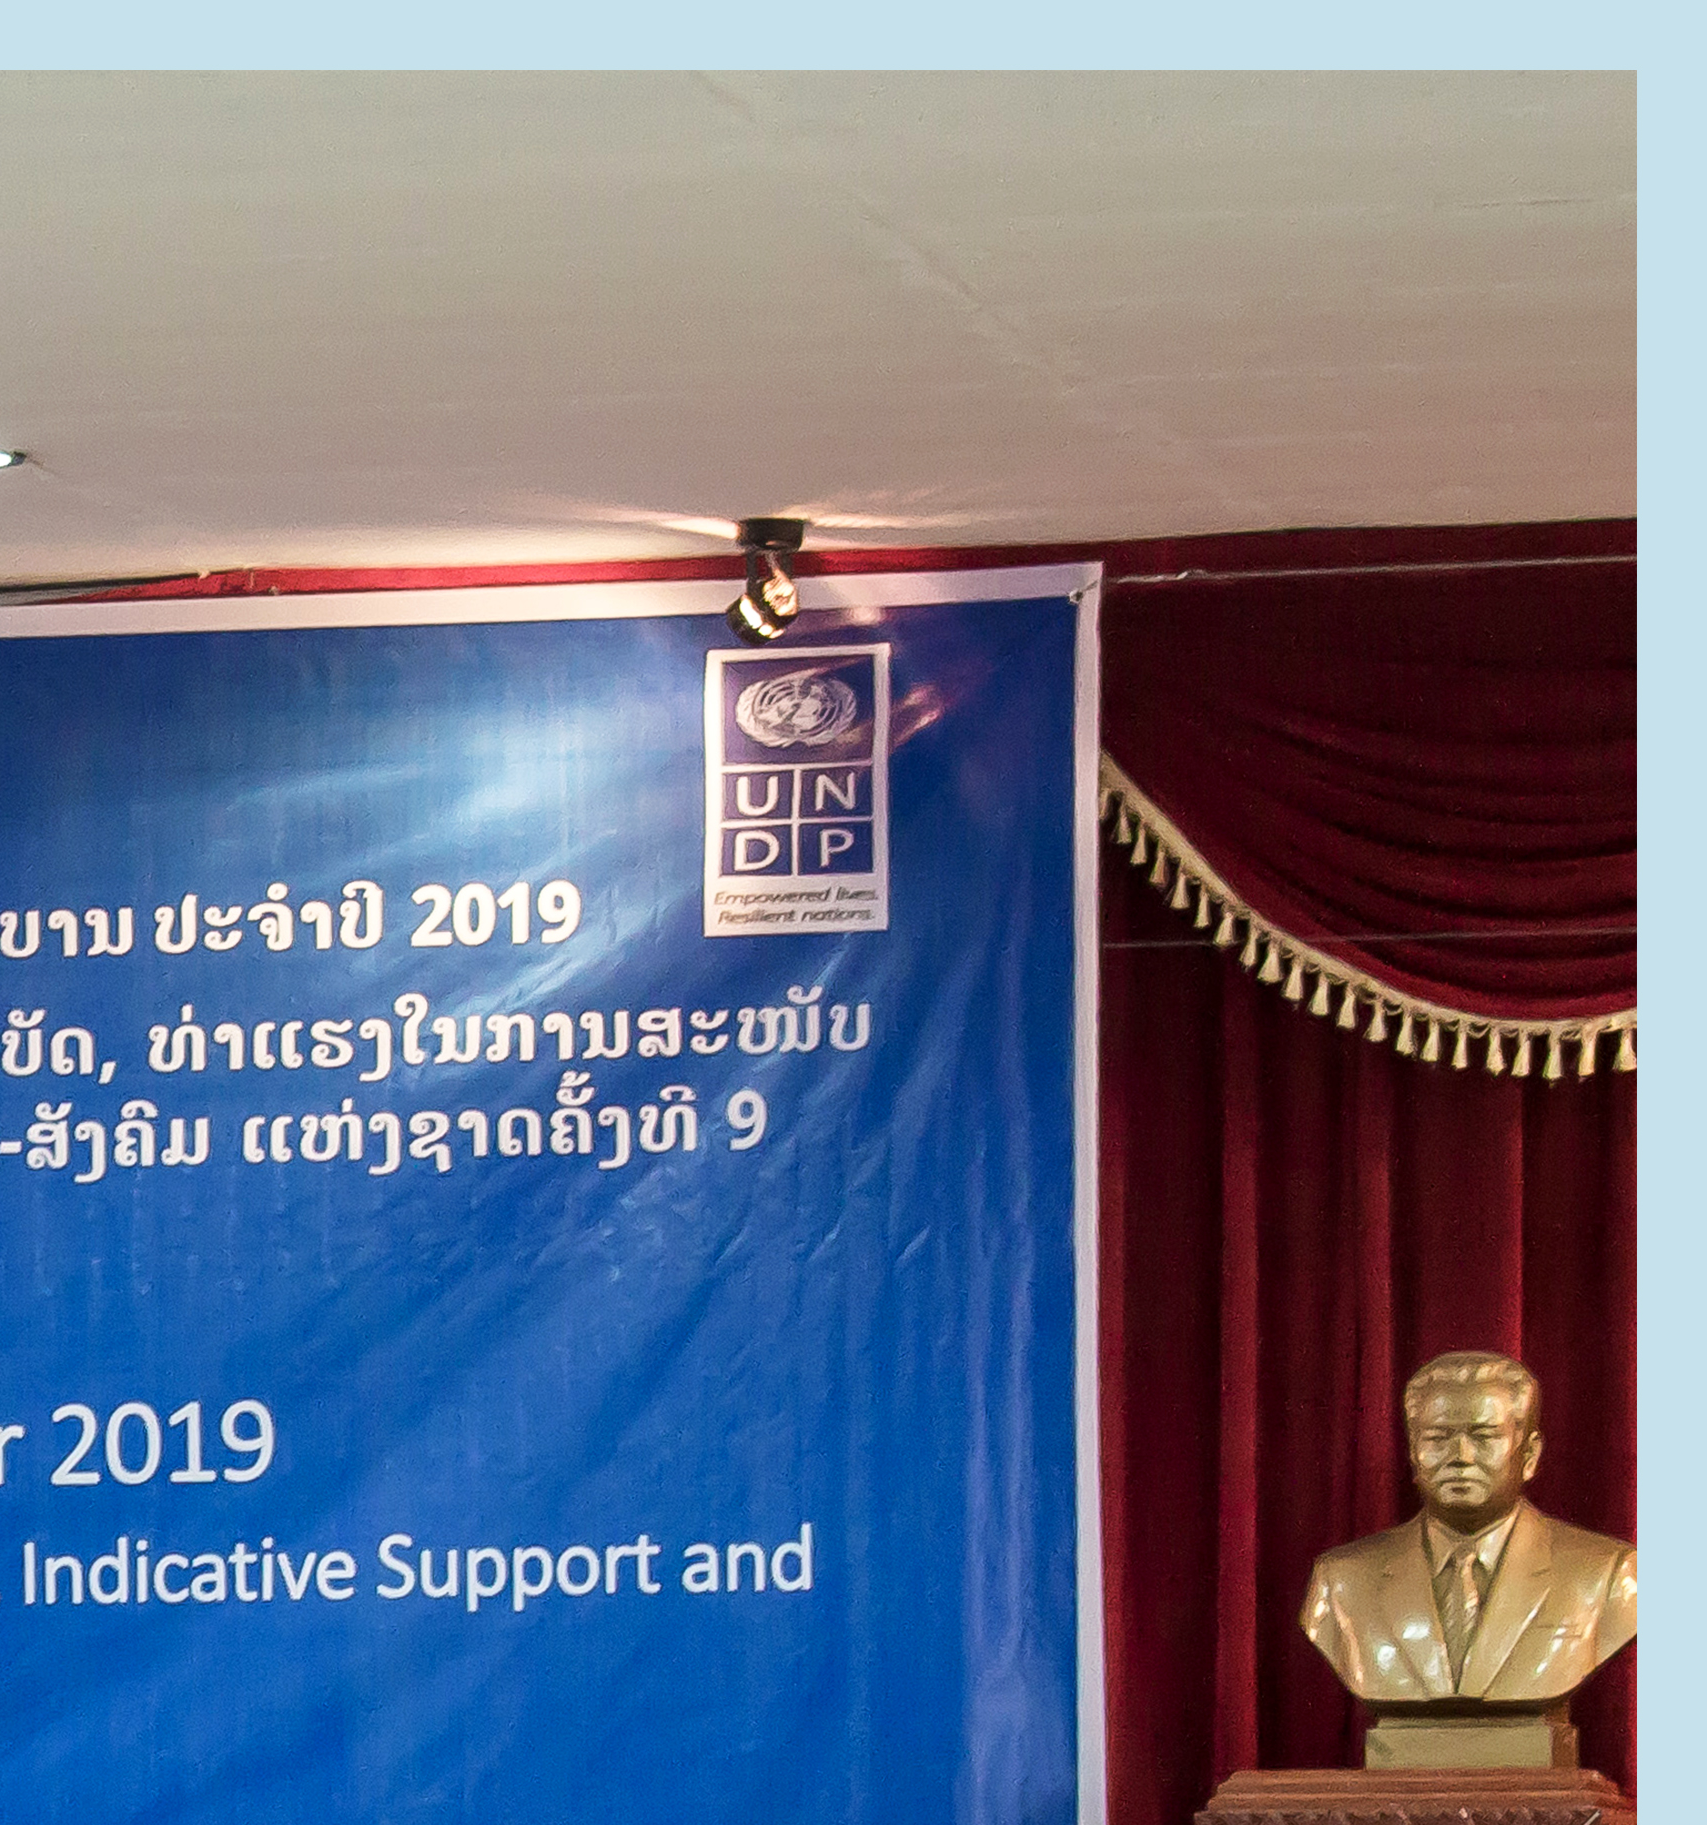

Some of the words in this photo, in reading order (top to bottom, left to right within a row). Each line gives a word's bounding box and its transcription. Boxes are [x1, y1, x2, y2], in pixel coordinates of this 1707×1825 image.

[411, 879, 581, 947] 2019
[727, 1090, 768, 1150] 9
[50, 1400, 276, 1486] 2019
[23, 1537, 357, 1604] Indicative
[377, 1533, 662, 1611] Support
[681, 1523, 813, 1594] and
